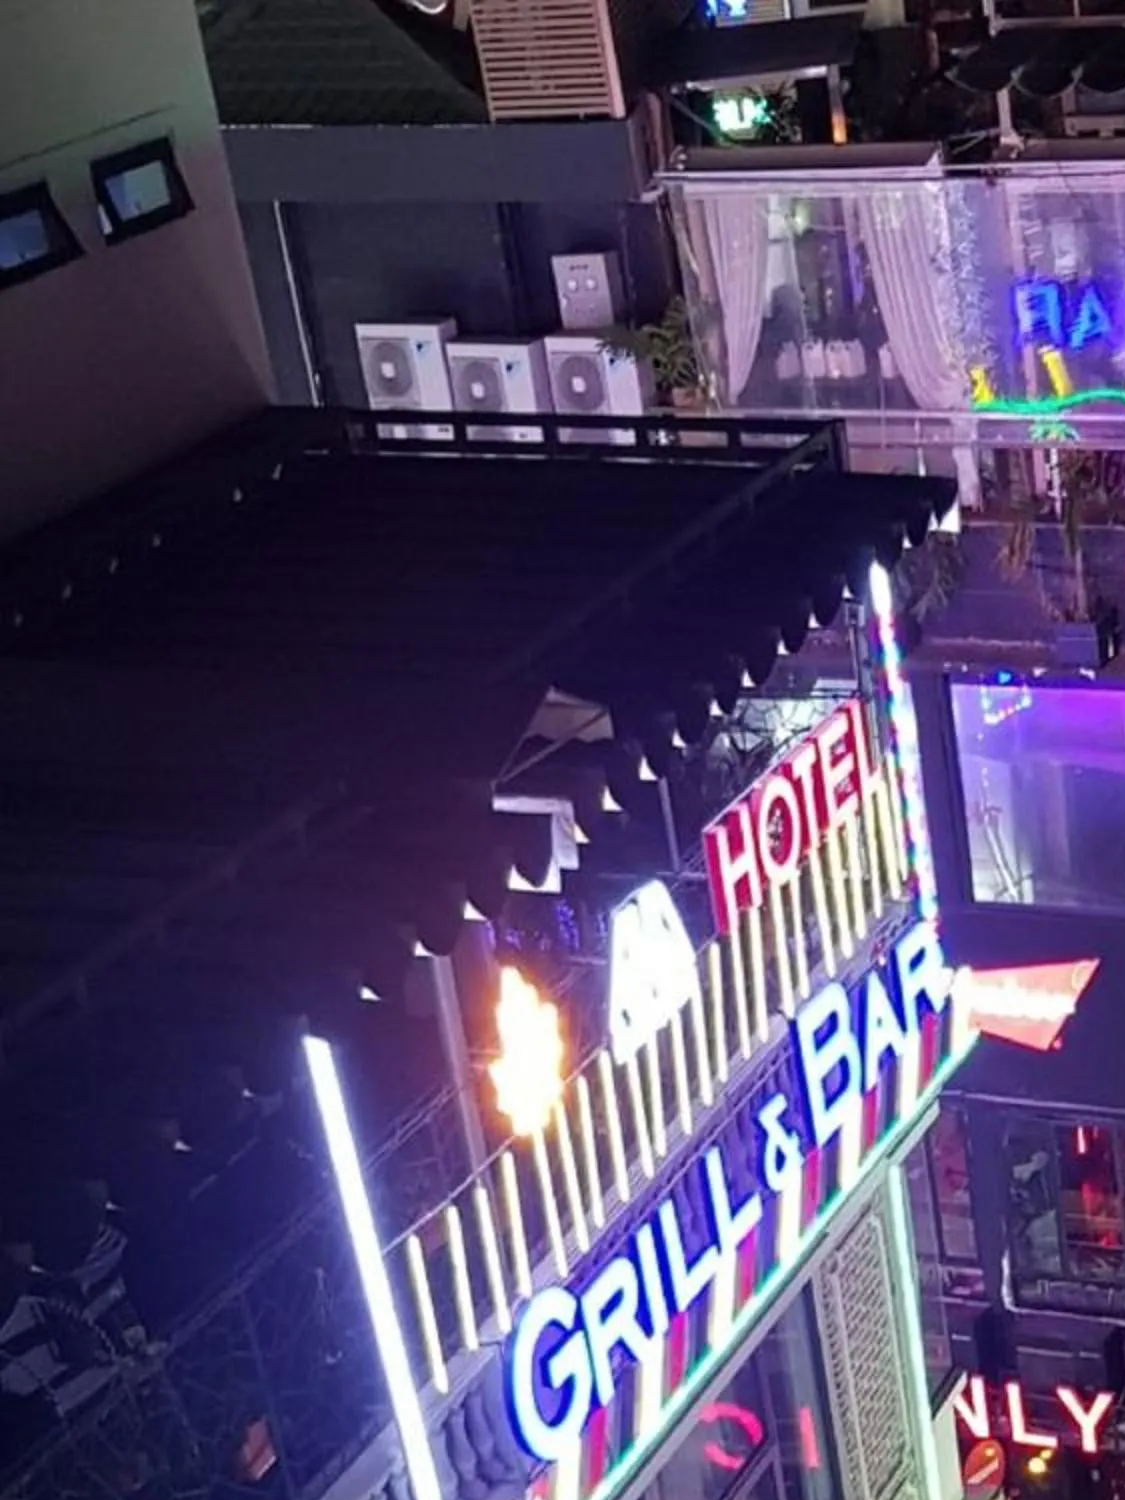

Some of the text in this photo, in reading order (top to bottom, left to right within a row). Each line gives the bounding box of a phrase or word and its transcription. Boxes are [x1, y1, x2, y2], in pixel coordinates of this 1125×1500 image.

[712, 701, 879, 922] HOTEL
[510, 923, 950, 1458] GRILL & BAR
